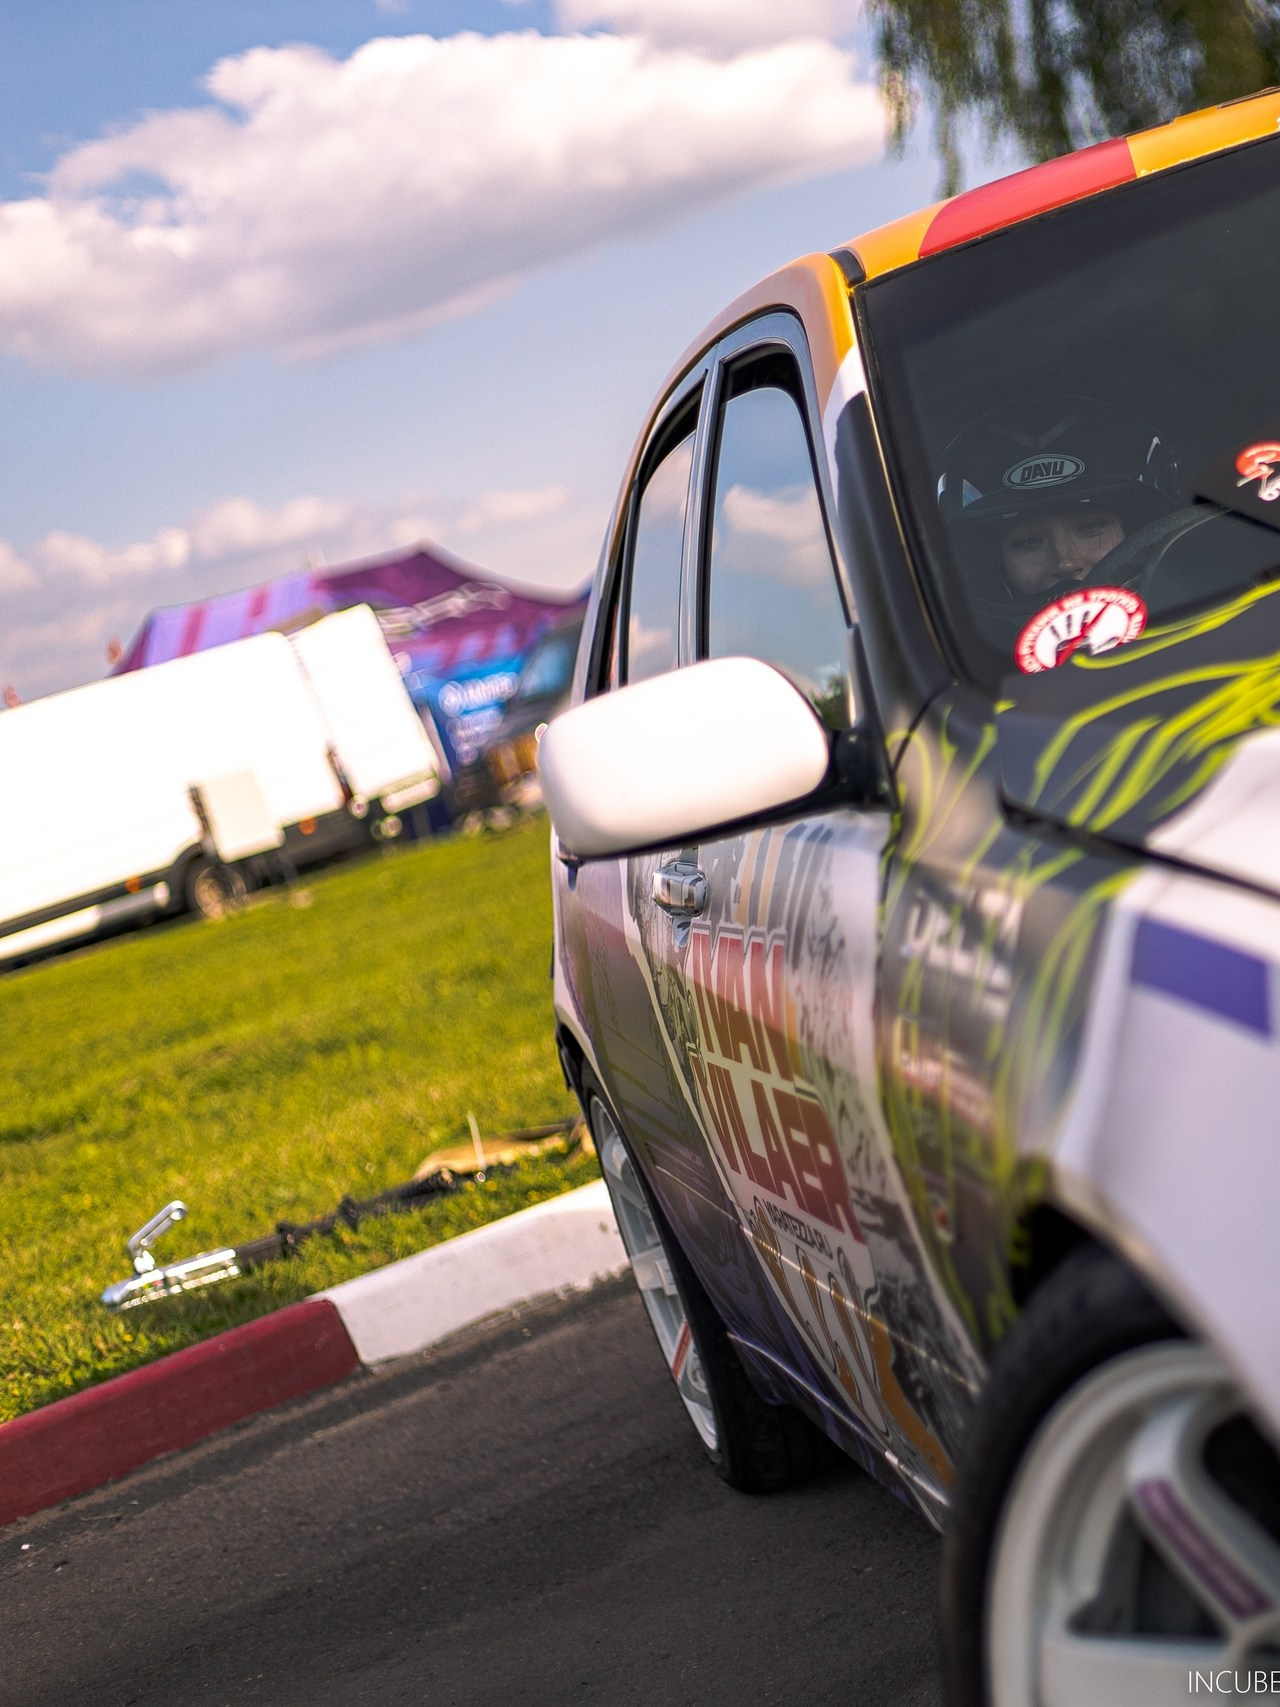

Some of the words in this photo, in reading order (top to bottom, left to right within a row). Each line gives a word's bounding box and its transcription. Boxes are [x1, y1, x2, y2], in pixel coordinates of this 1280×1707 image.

[1020, 460, 1066, 482] DAYU
[692, 931, 791, 1083] IVAN
[689, 1054, 868, 1246] VILAER
